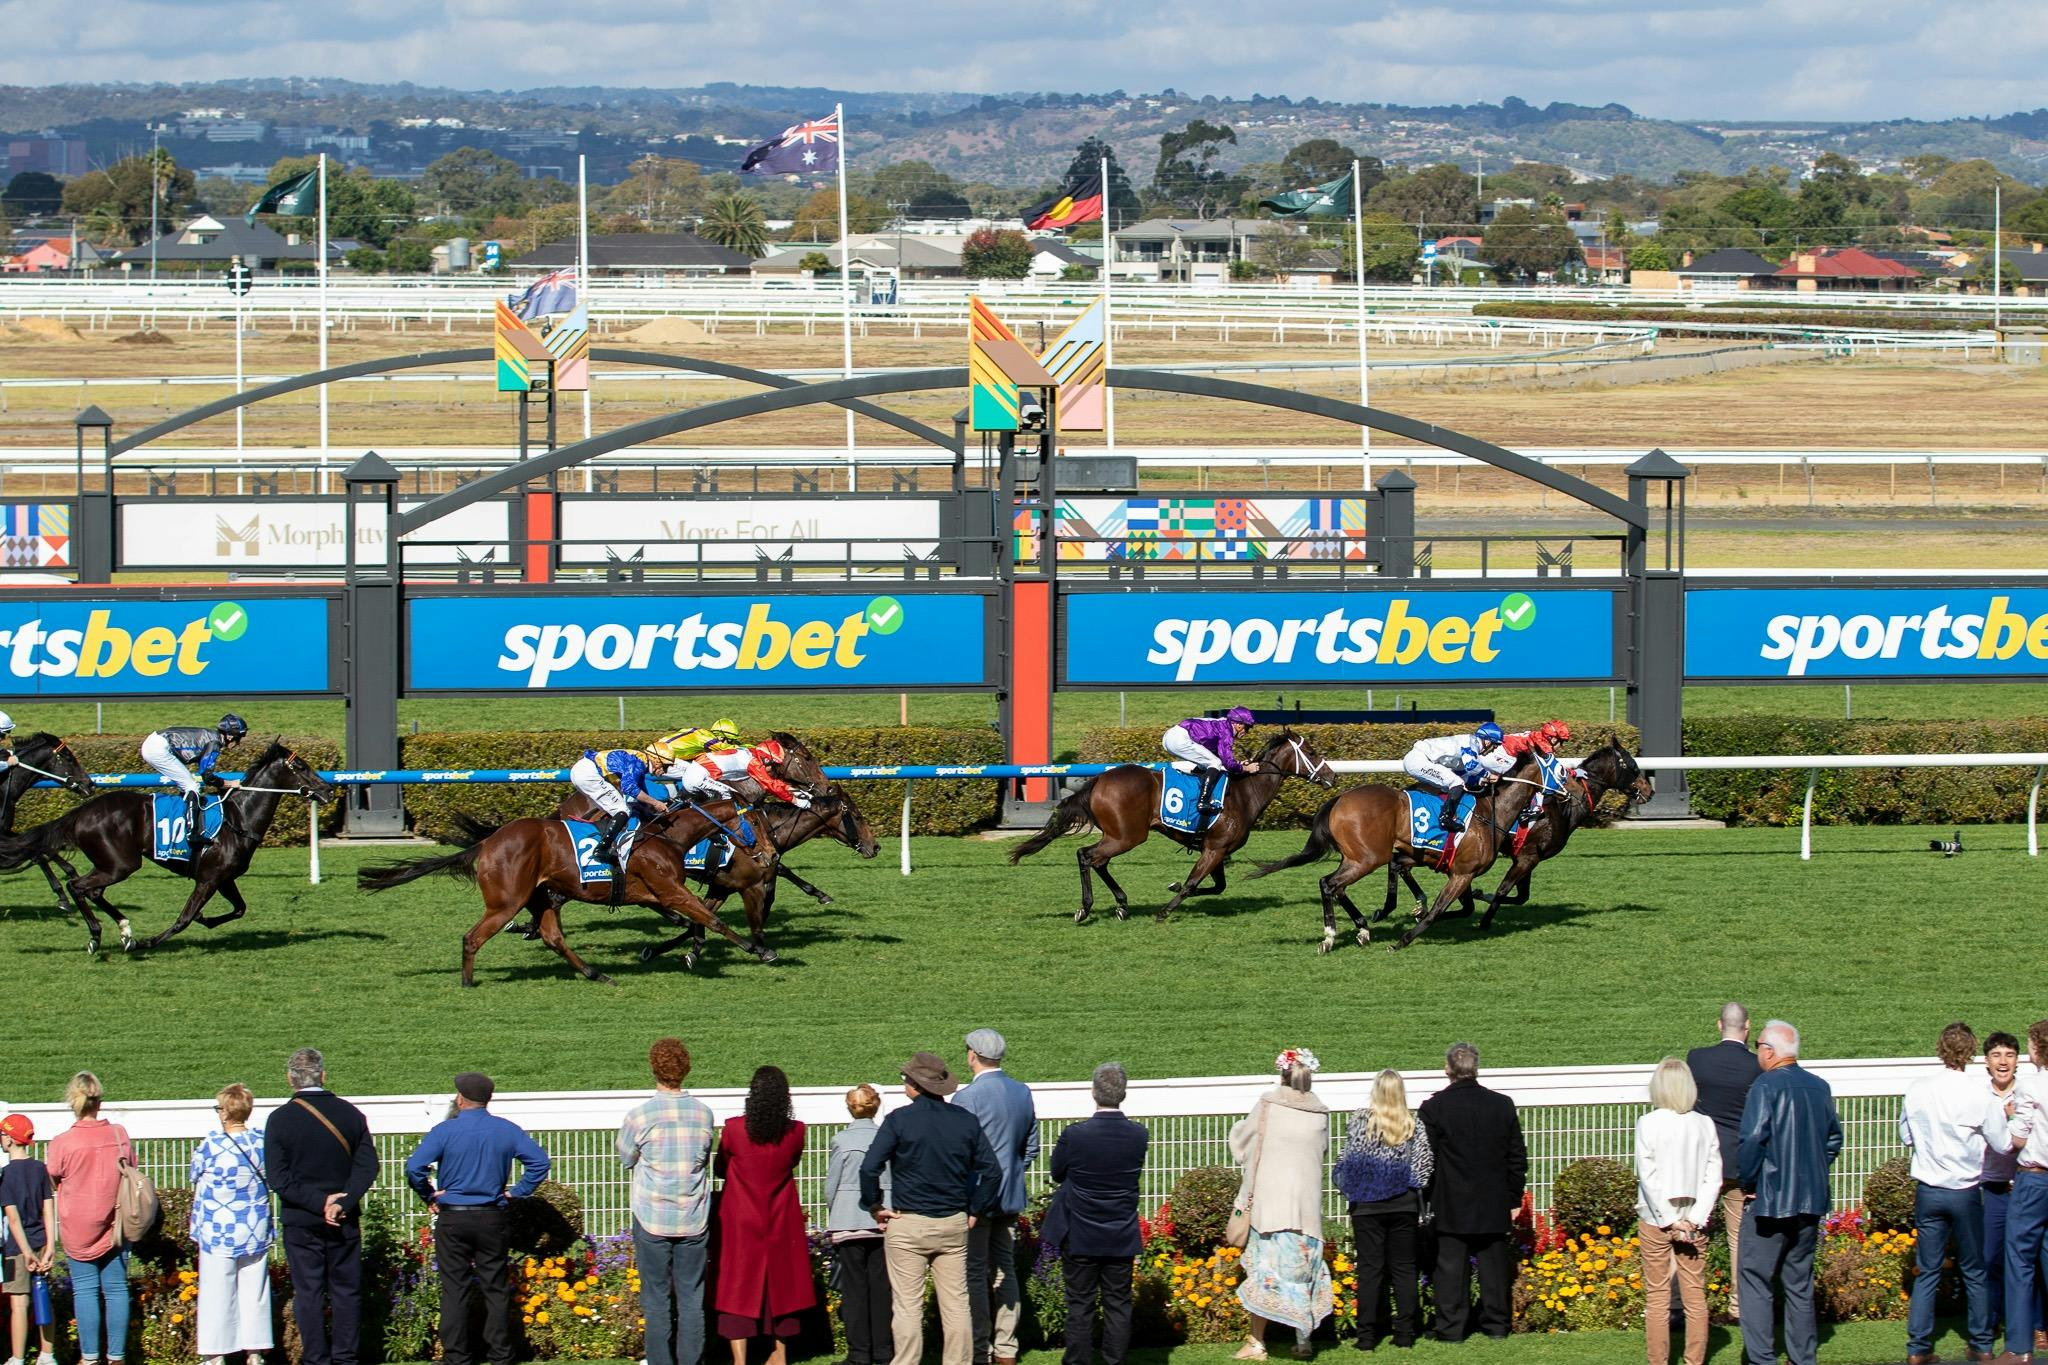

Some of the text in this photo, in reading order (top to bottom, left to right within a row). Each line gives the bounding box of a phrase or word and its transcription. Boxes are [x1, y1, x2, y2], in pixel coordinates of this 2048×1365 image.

[0, 609, 213, 678] tsbet
[498, 603, 870, 688] sportsbet
[1147, 599, 1503, 682] sportsbet
[334, 771, 382, 782] sportsbet
[422, 771, 469, 781] sportsbet
[508, 770, 556, 781] sportsbet
[850, 766, 897, 776] sportsbet
[936, 766, 983, 776] sportsbet
[1020, 765, 1067, 775] sportsbet
[1165, 787, 1184, 814] 6
[157, 817, 186, 846] 10
[1414, 807, 1431, 833] 3
[578, 838, 602, 867] 2
